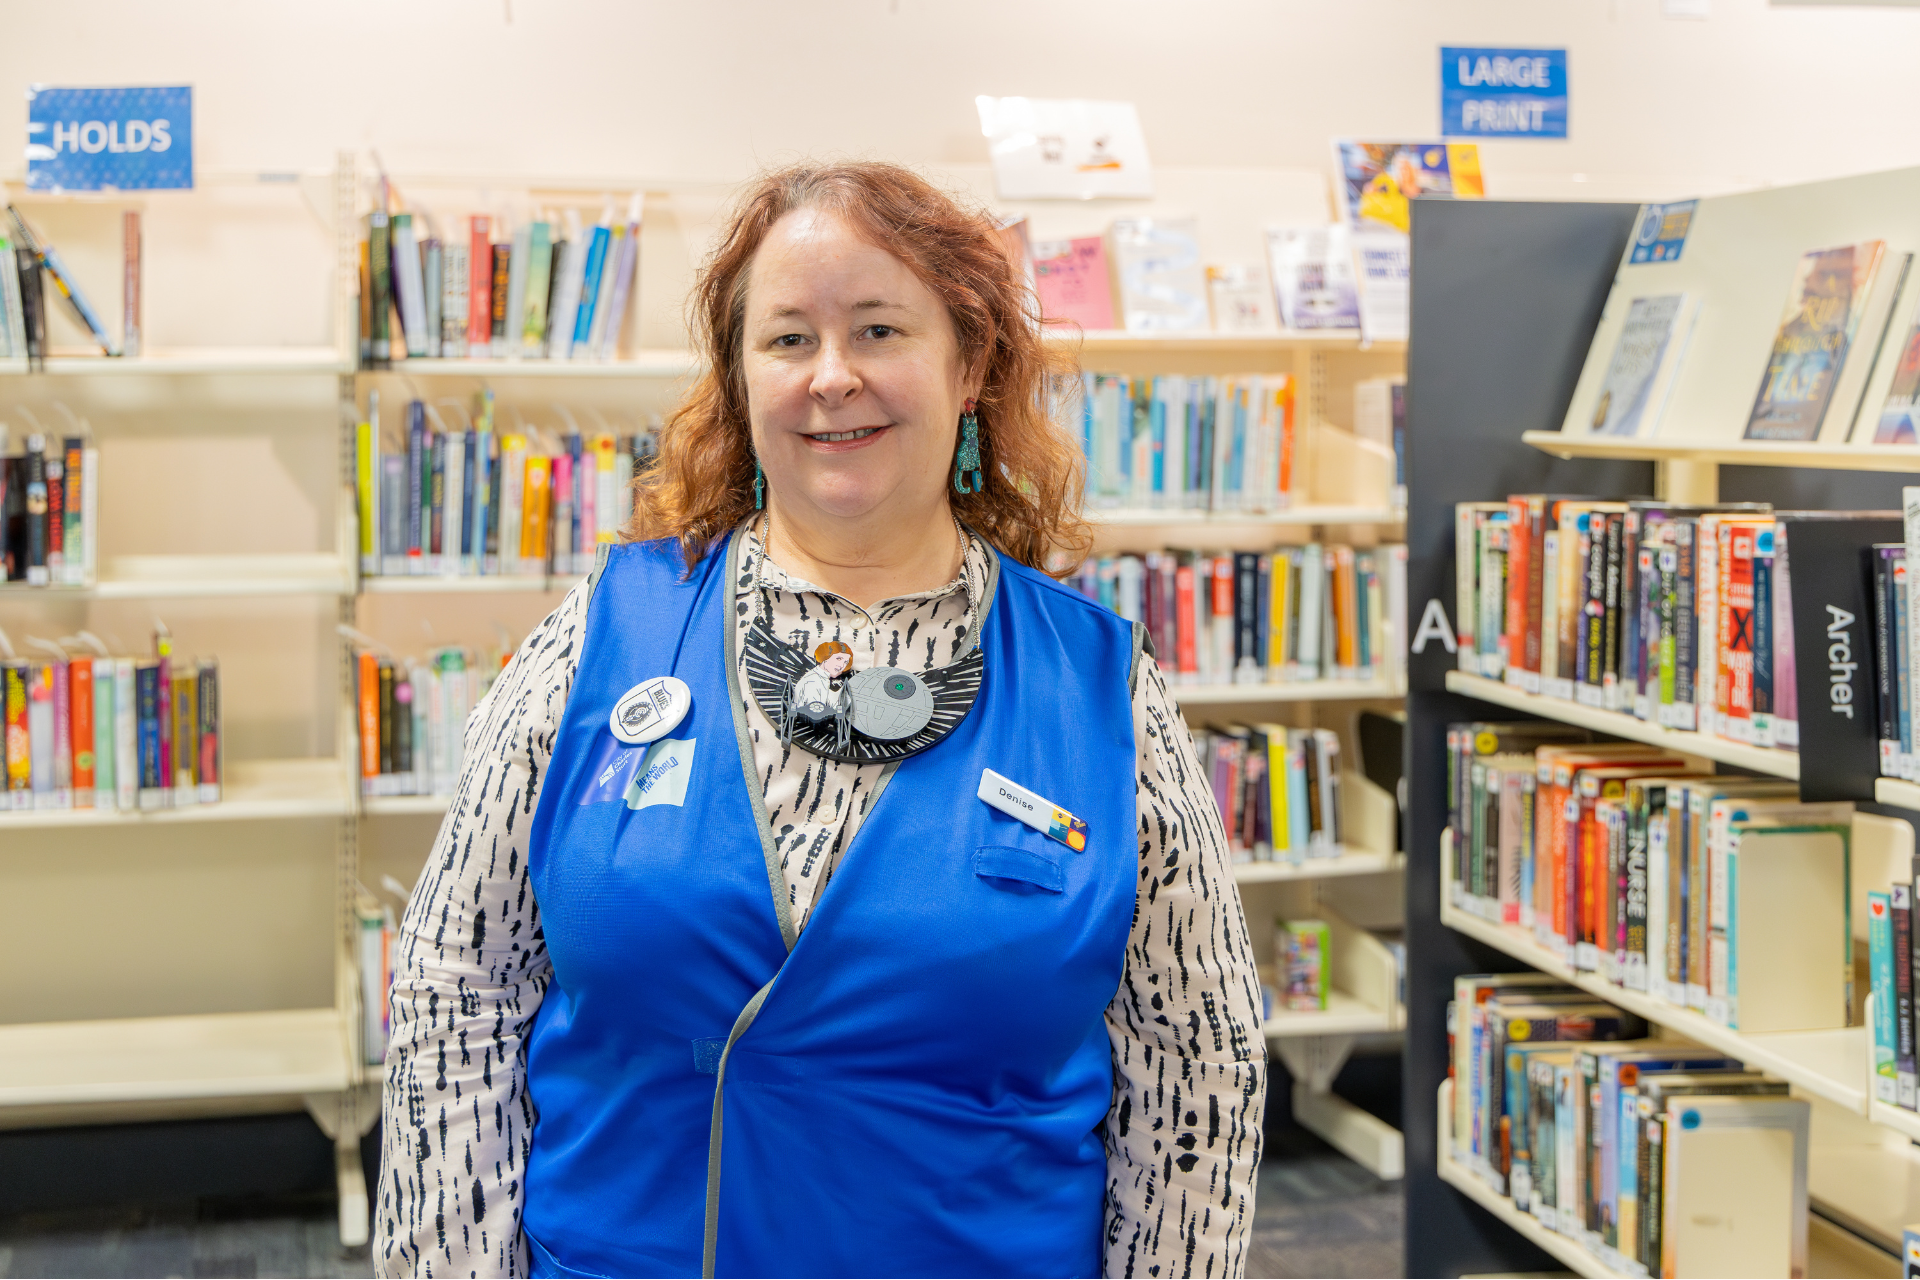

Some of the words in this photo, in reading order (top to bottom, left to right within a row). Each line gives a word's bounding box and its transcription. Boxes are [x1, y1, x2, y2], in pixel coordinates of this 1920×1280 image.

[1458, 56, 1551, 88] LARGE
[1461, 100, 1548, 131] PRINT
[52, 119, 172, 154] HOLDS
[1411, 599, 1457, 655] A
[1825, 604, 1858, 719] Archer
[653, 689, 670, 711] BLUES
[614, 751, 633, 769] Charles
[615, 759, 629, 774] Sturt
[641, 780, 655, 794] THE
[652, 756, 679, 781] WORLD
[636, 764, 659, 789] MEANS
[998, 787, 1034, 811] Denise
[1627, 839, 1647, 919] NURSE
